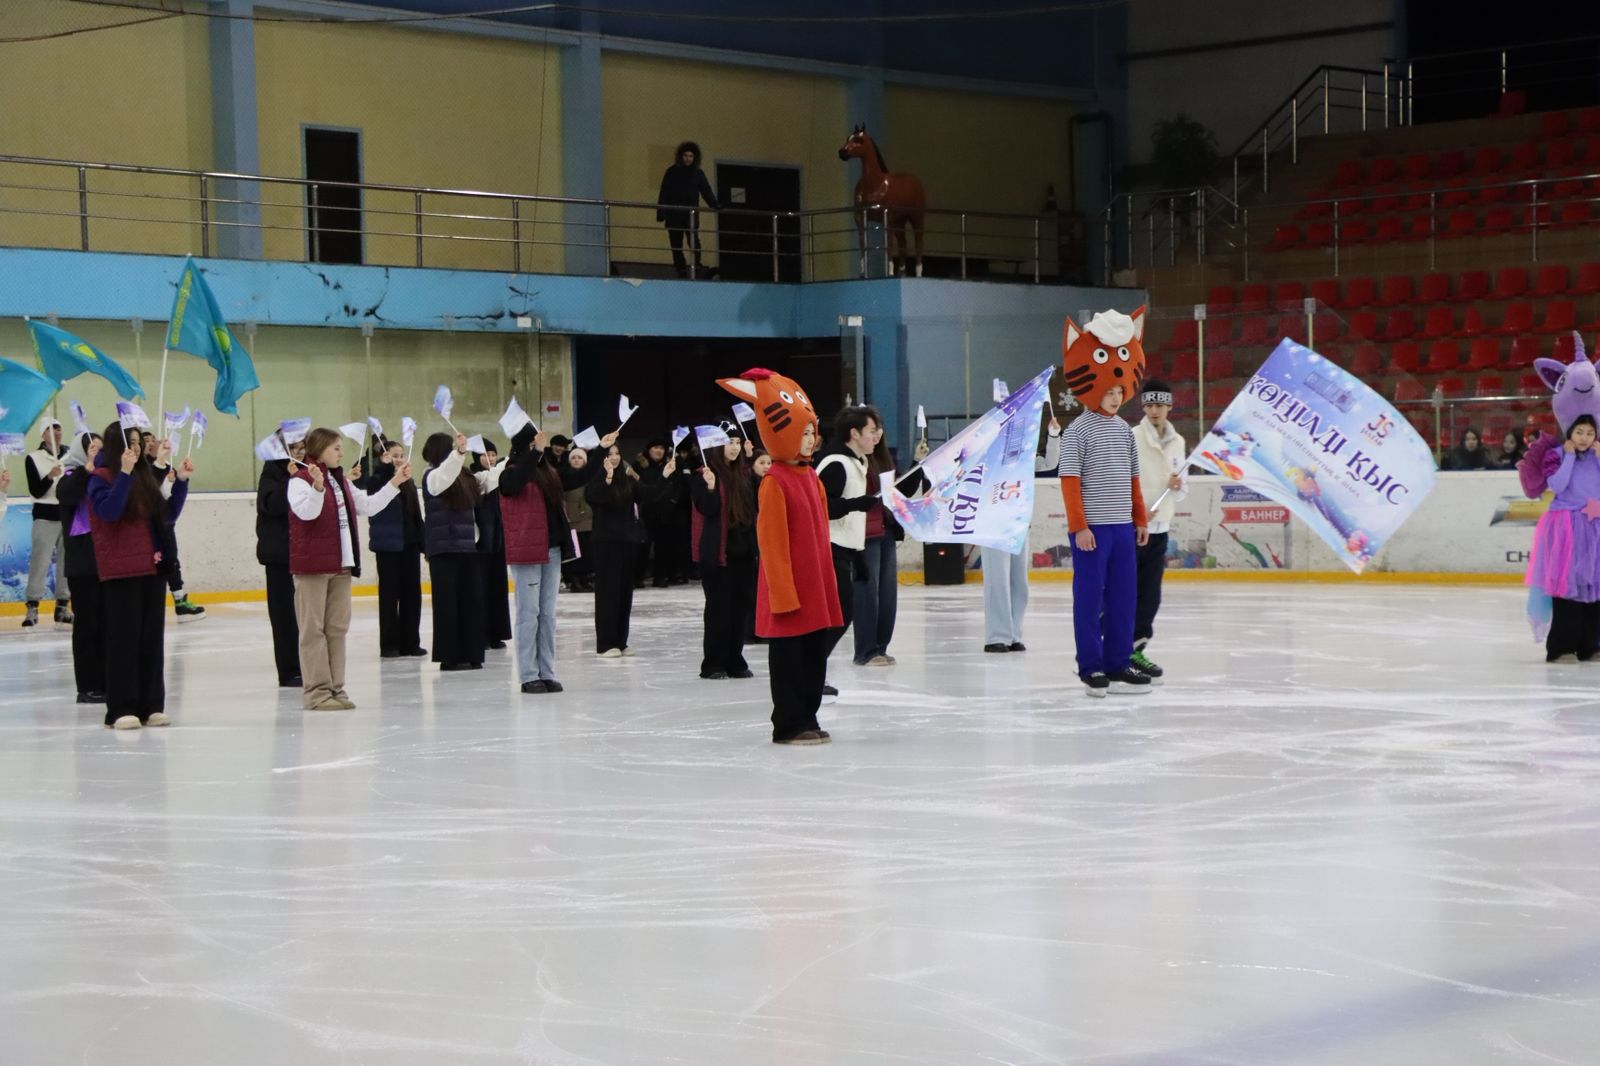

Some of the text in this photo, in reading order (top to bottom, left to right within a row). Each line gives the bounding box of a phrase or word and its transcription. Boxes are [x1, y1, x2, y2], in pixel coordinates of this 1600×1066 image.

[1346, 450, 1409, 506] ҚЫС
[949, 493, 979, 535] ҚЫ
[1241, 510, 1286, 520] БАННЕР
